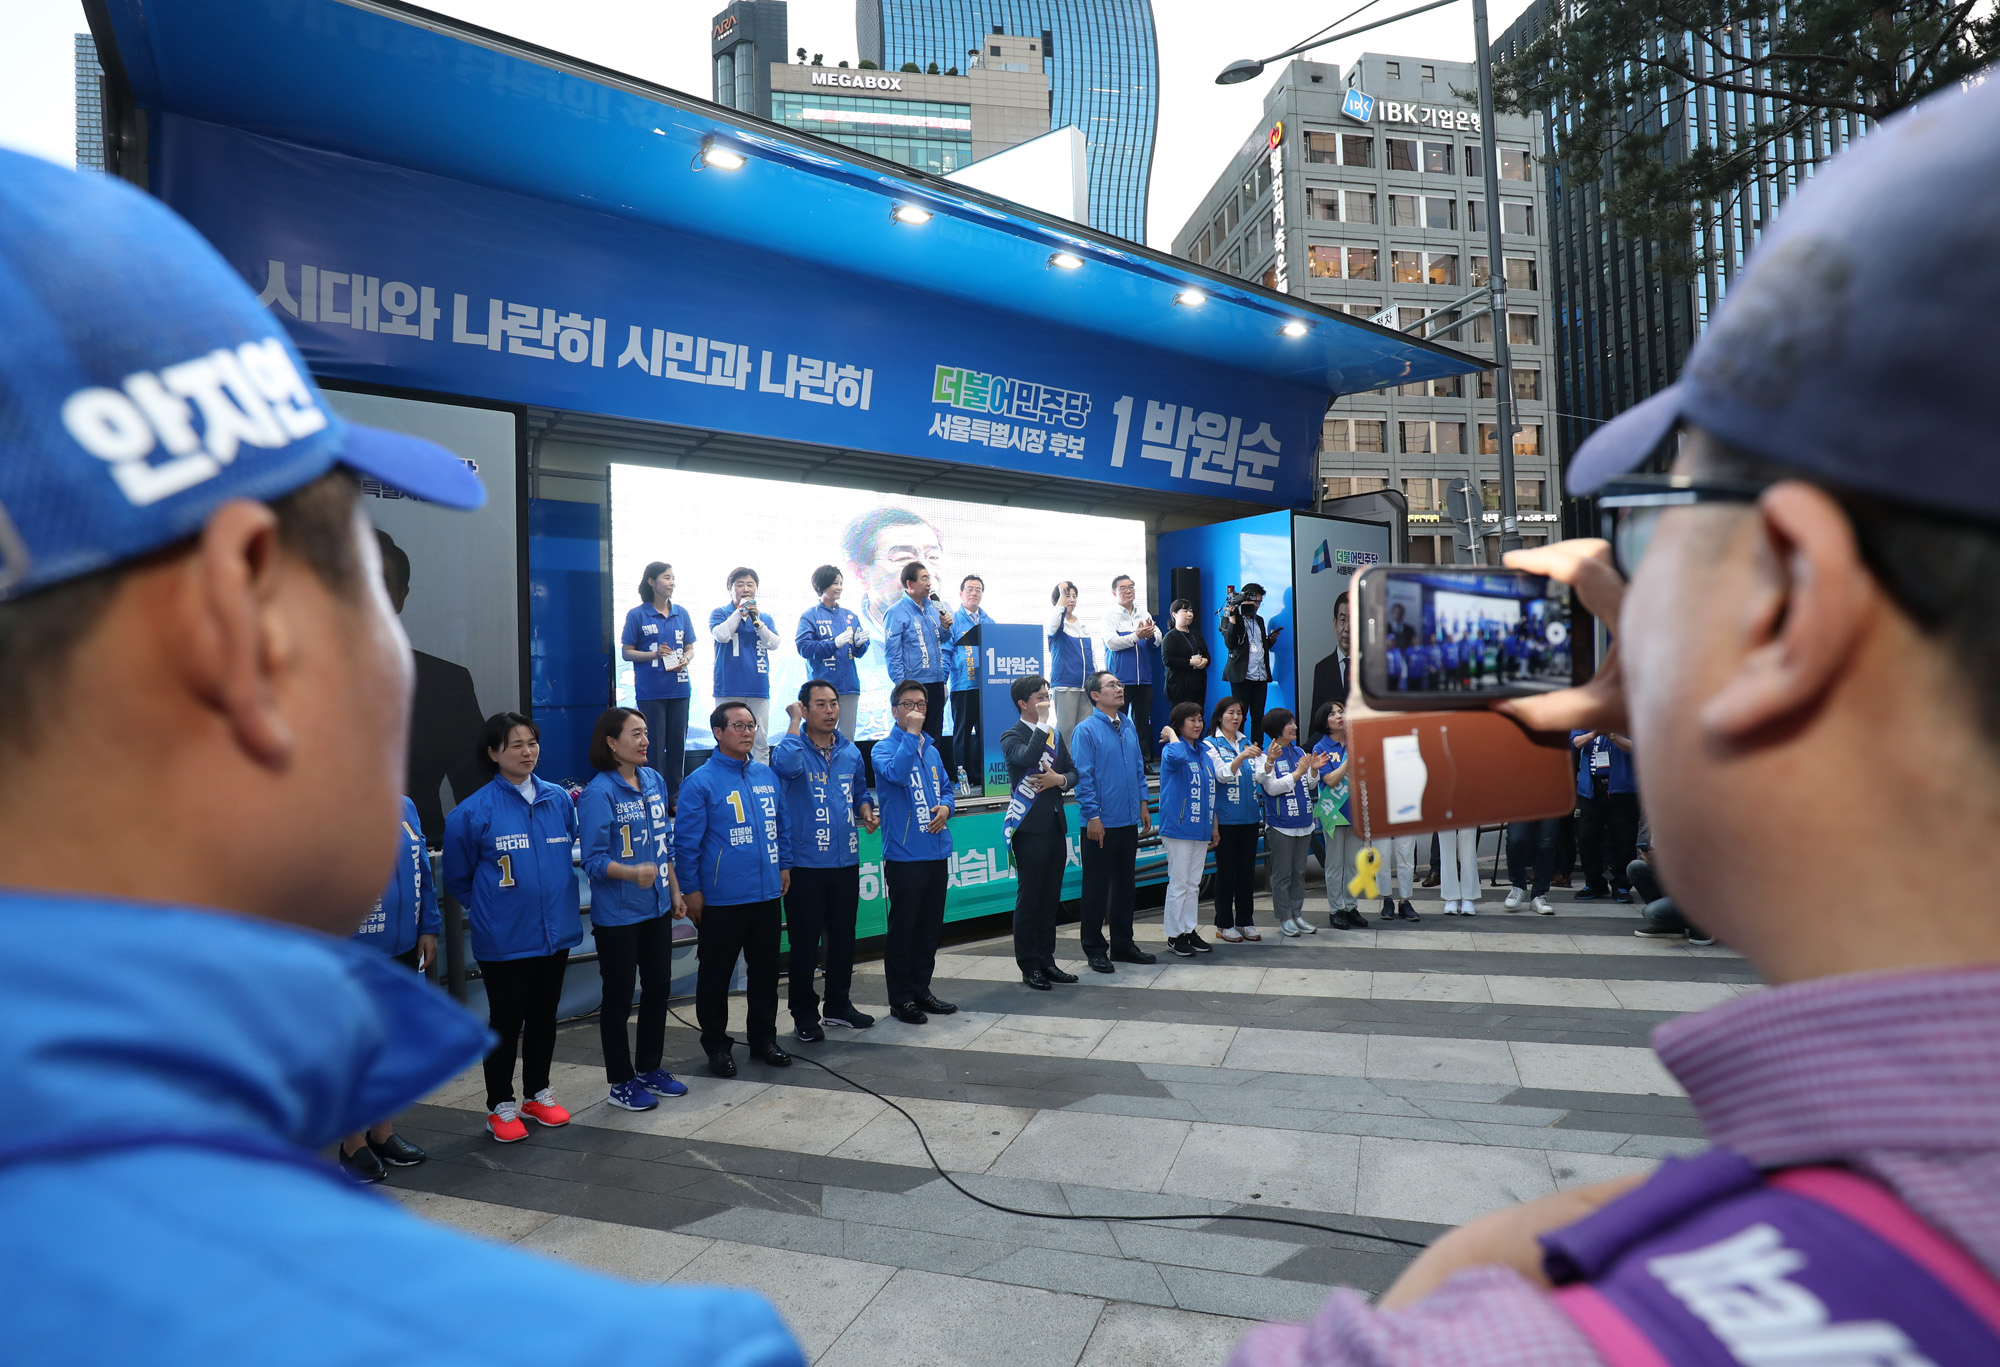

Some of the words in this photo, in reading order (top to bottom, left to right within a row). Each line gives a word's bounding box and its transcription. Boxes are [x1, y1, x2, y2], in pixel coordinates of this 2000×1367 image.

[713, 14, 738, 39] ARA
[811, 71, 902, 91] MEGABOX
[1378, 101, 1419, 124] IBK
[255, 260, 441, 341] 시대와
[452, 293, 606, 368] 나란히
[617, 325, 752, 391] 시민과
[758, 350, 874, 411] 나란히
[931, 364, 1093, 429] 더불어민주당
[60, 336, 328, 507] 안지연
[928, 412, 1048, 455] 서울특별시장
[1048, 432, 1086, 460] 후보
[1110, 395, 1134, 468] 1
[1140, 399, 1282, 492] 박원순
[1335, 549, 1380, 566] 더불어민주당
[986, 647, 996, 676] 1
[996, 656, 1041, 676] 박원순
[988, 761, 1007, 774] 시대
[726, 790, 746, 824] 1
[909, 767, 931, 824] 시의원
[1190, 773, 1201, 815] 시의원
[729, 826, 753, 838] 더불어
[760, 796, 779, 865] 김평남
[814, 787, 831, 846] 구의원
[496, 838, 530, 851] 박다미
[730, 835, 754, 847] 민주당
[497, 854, 516, 888] 1
